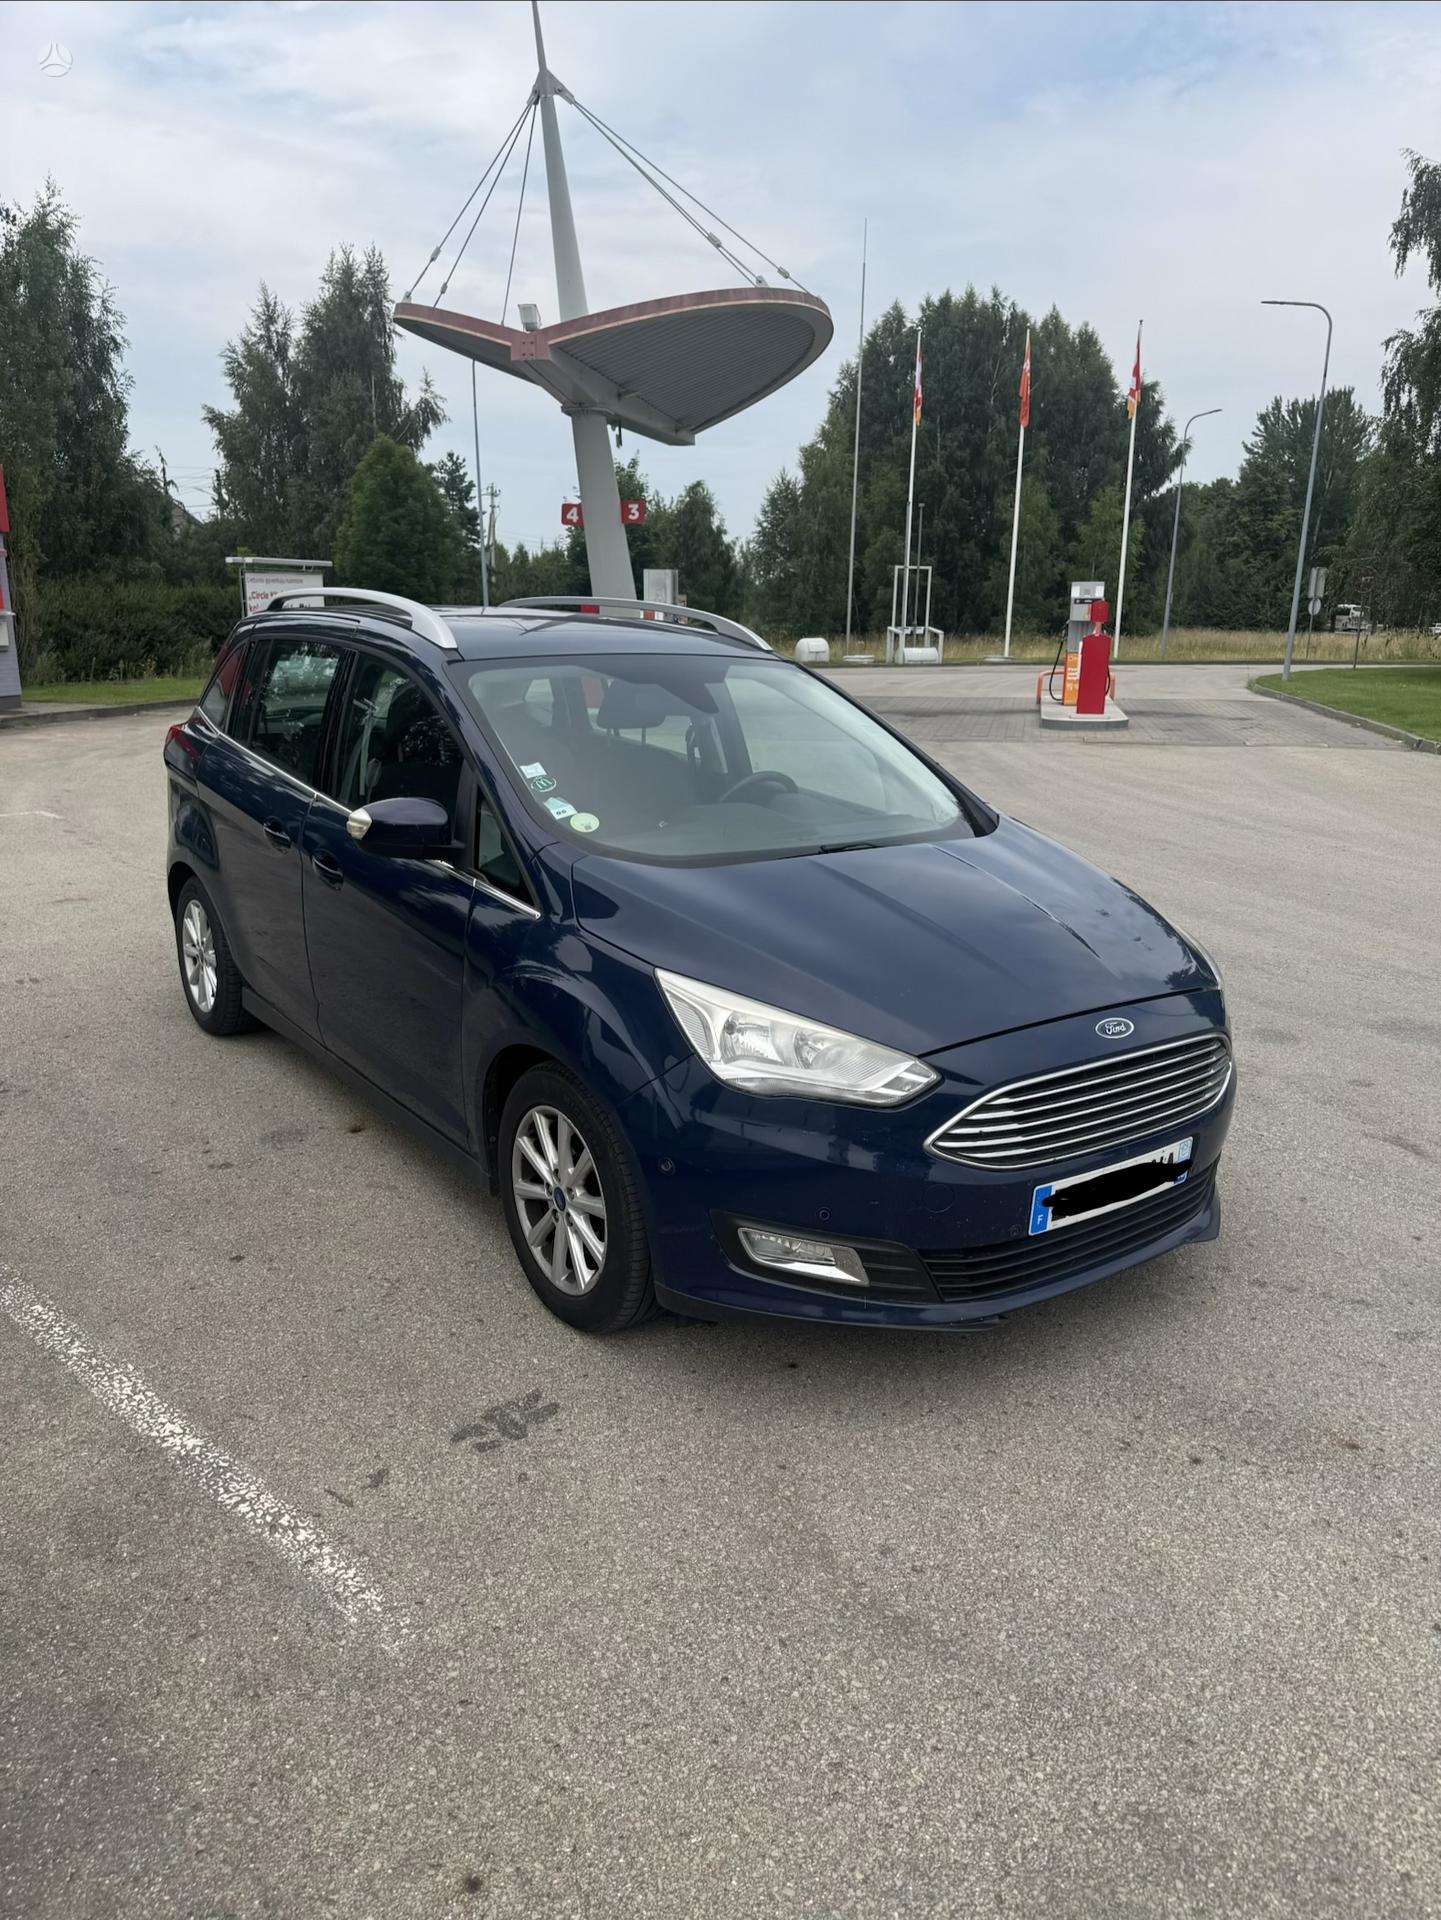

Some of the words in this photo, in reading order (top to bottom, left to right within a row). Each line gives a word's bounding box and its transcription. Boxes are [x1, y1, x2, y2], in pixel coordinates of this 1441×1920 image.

[567, 507, 579, 523] 4
[628, 503, 640, 520] 3
[1105, 1022, 1126, 1034] Ford
[1037, 1214, 1044, 1225] F
